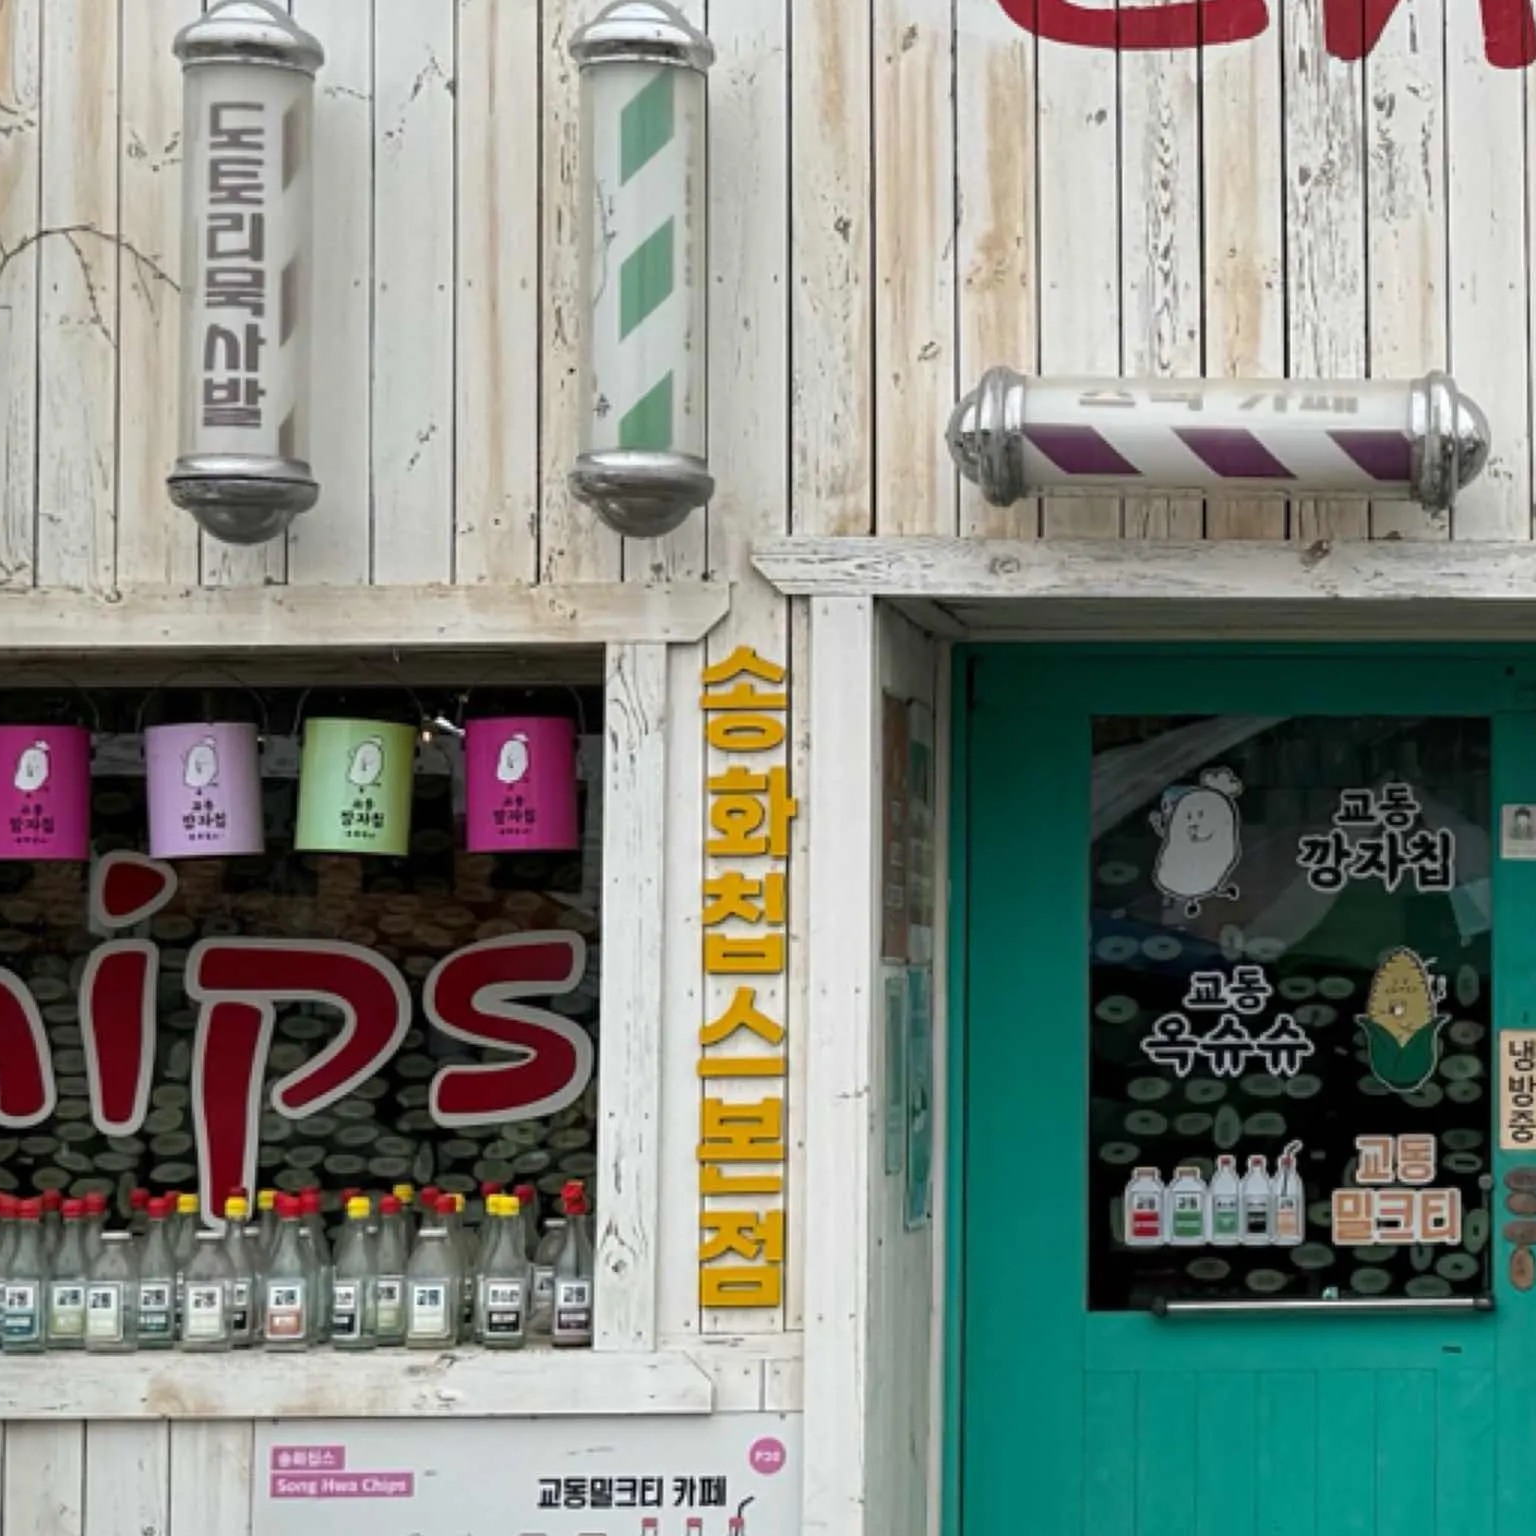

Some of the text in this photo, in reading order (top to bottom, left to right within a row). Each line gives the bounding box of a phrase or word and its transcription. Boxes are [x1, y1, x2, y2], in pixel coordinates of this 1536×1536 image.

[202, 100, 266, 430] 도토리묵사발
[1335, 785, 1421, 828] 교동
[1298, 830, 1454, 889] 깡자칩
[696, 645, 796, 1309] 송화칩스본점
[1183, 966, 1271, 1011] 교동
[1142, 1014, 1314, 1076] 옥슈슈
[1356, 1133, 1436, 1183] 교동
[1332, 1188, 1461, 1245] 밀크티
[278, 1478, 407, 1494] Song Hwa Chips
[537, 1475, 727, 1508] 교동밀크티 카페
